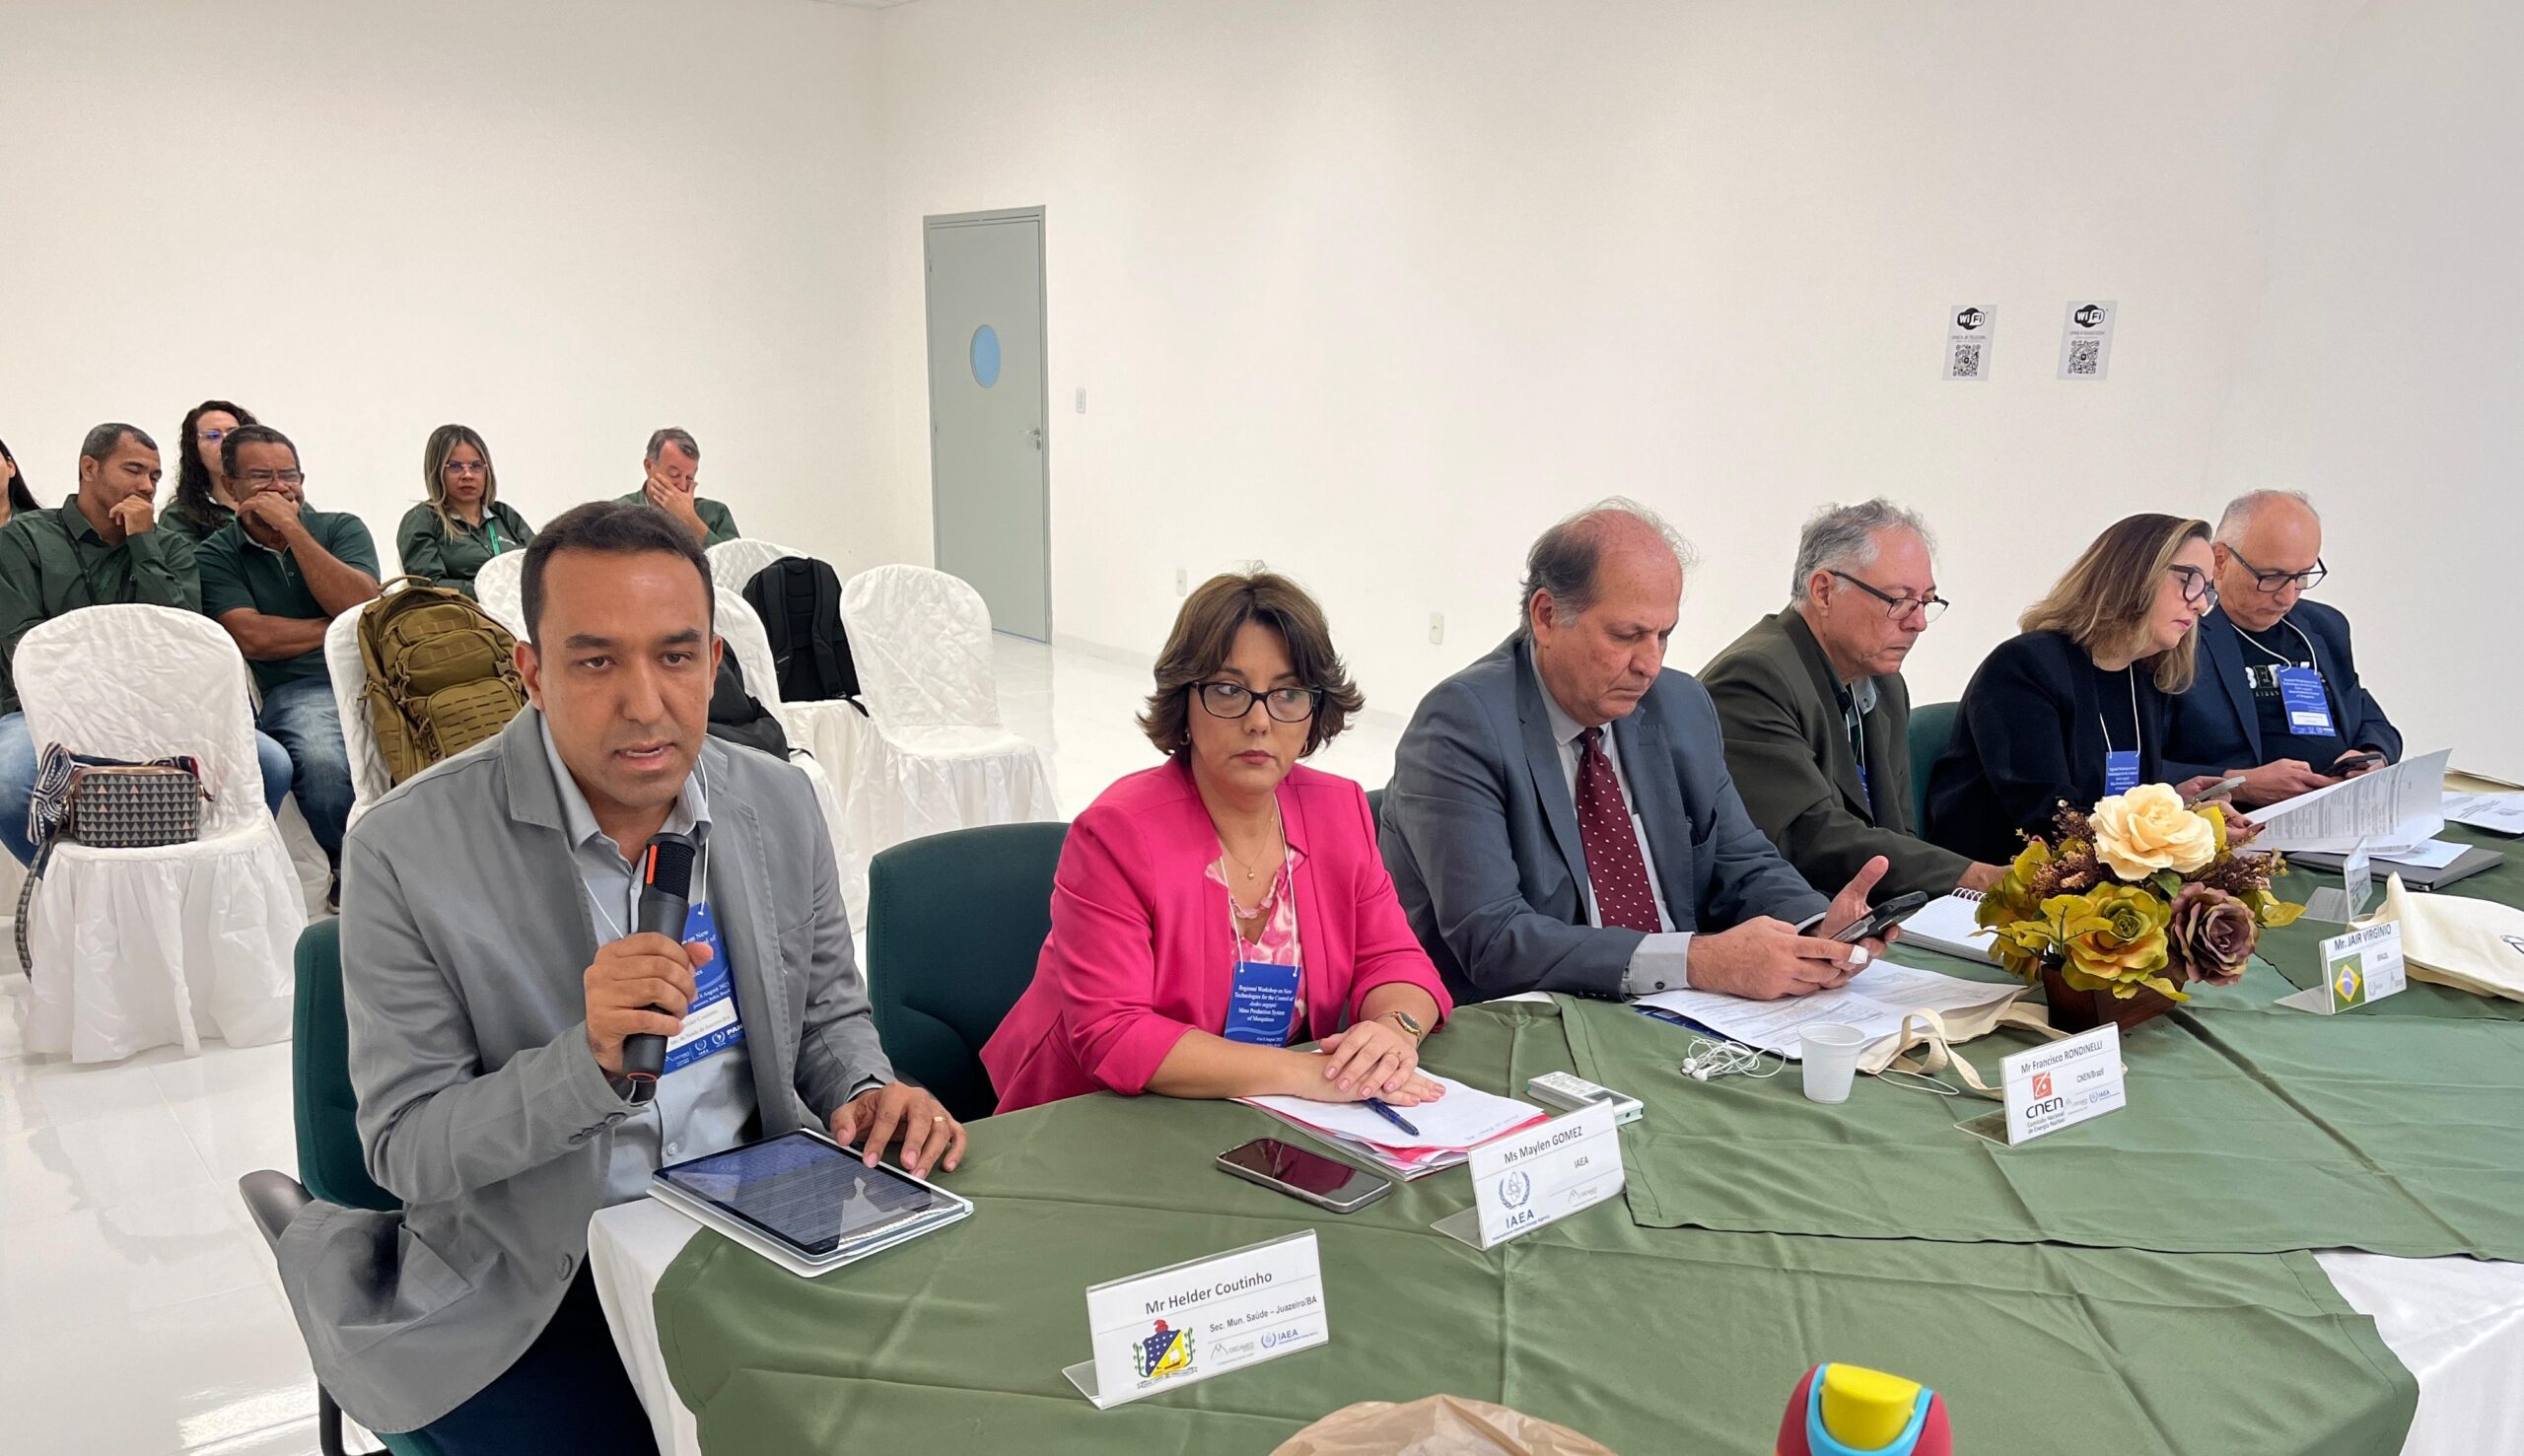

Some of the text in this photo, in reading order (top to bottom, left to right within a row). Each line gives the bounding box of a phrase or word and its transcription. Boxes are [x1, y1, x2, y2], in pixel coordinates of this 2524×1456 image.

[2334, 924, 2392, 951] Mr. JAIR VIRGINIO
[1238, 984, 1257, 993] Regional
[1257, 986, 1278, 995] Workshop
[2021, 1040, 2103, 1075] Mr Francisco RONDINELLI
[1504, 1126, 1583, 1164] Ms Maylen GOMEZ
[1574, 1156, 1589, 1168] IAEA
[1506, 1209, 1535, 1229] IAEA
[1145, 1272, 1273, 1316] Mr Helder Coutinho
[1209, 1323, 1226, 1333] Sec.
[1227, 1317, 1244, 1328] Mun.
[1246, 1310, 1269, 1322] Saúde
[1276, 1295, 1317, 1314] Juazeiro/BA
[1278, 1329, 1298, 1341] IAEA
